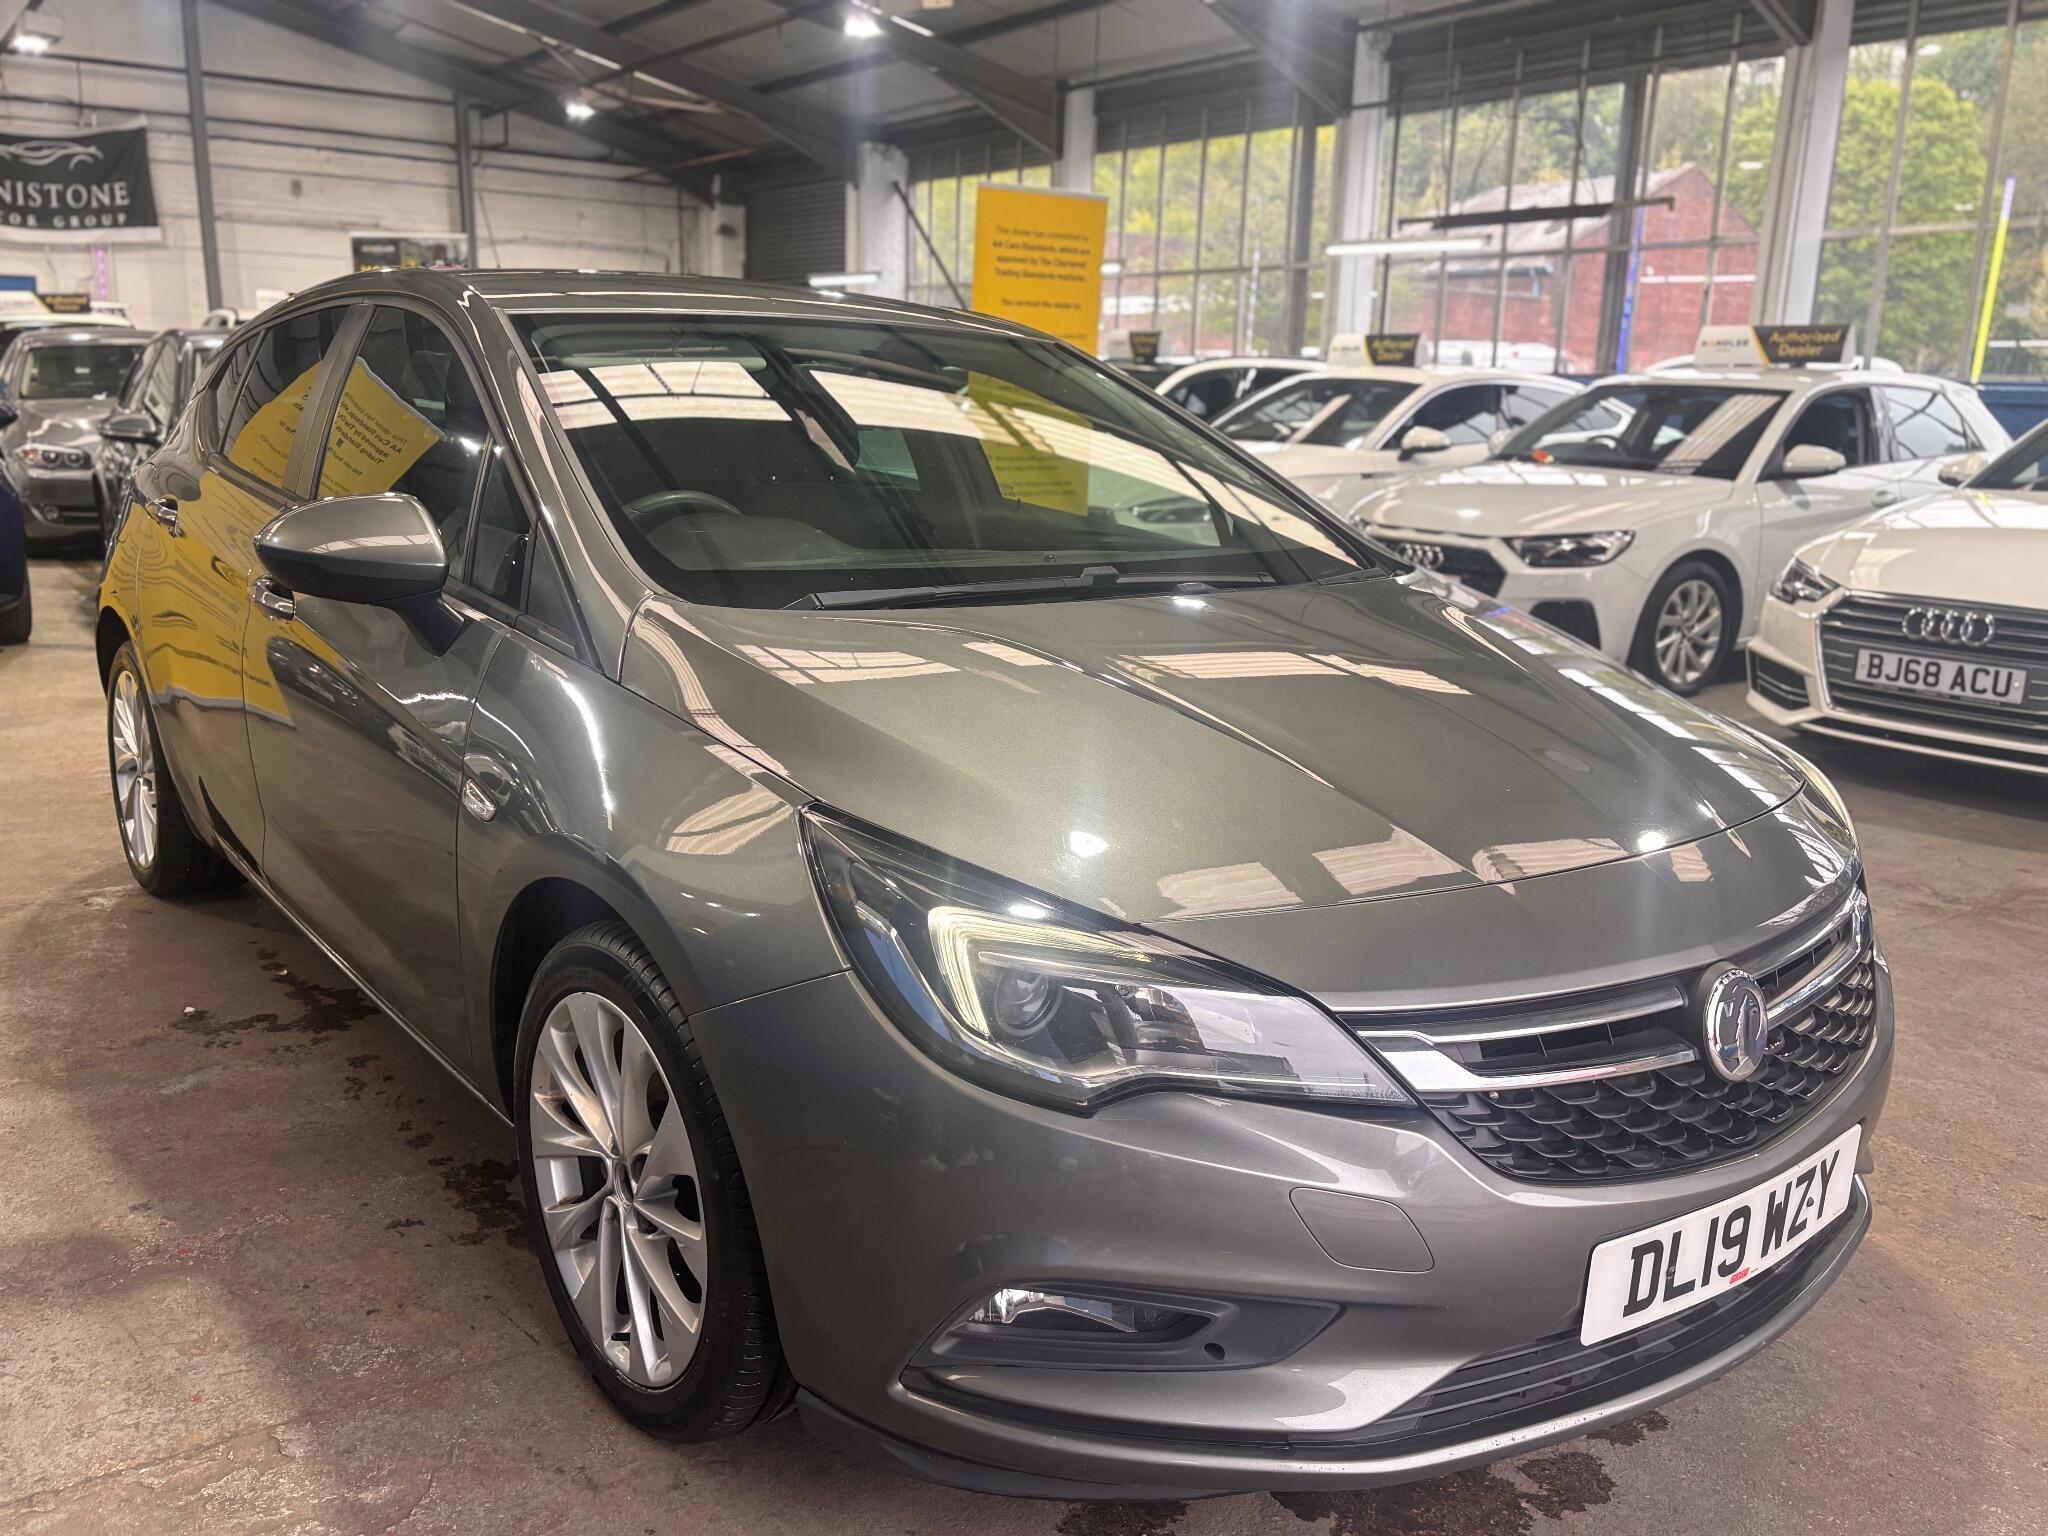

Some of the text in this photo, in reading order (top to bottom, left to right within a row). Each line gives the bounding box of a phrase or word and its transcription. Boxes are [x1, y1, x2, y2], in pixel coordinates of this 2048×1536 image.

[53, 212, 127, 229] GROUP
[1866, 653, 2013, 698] BJ68 ACU
[1622, 1150, 1840, 1318] DL19 WZY
